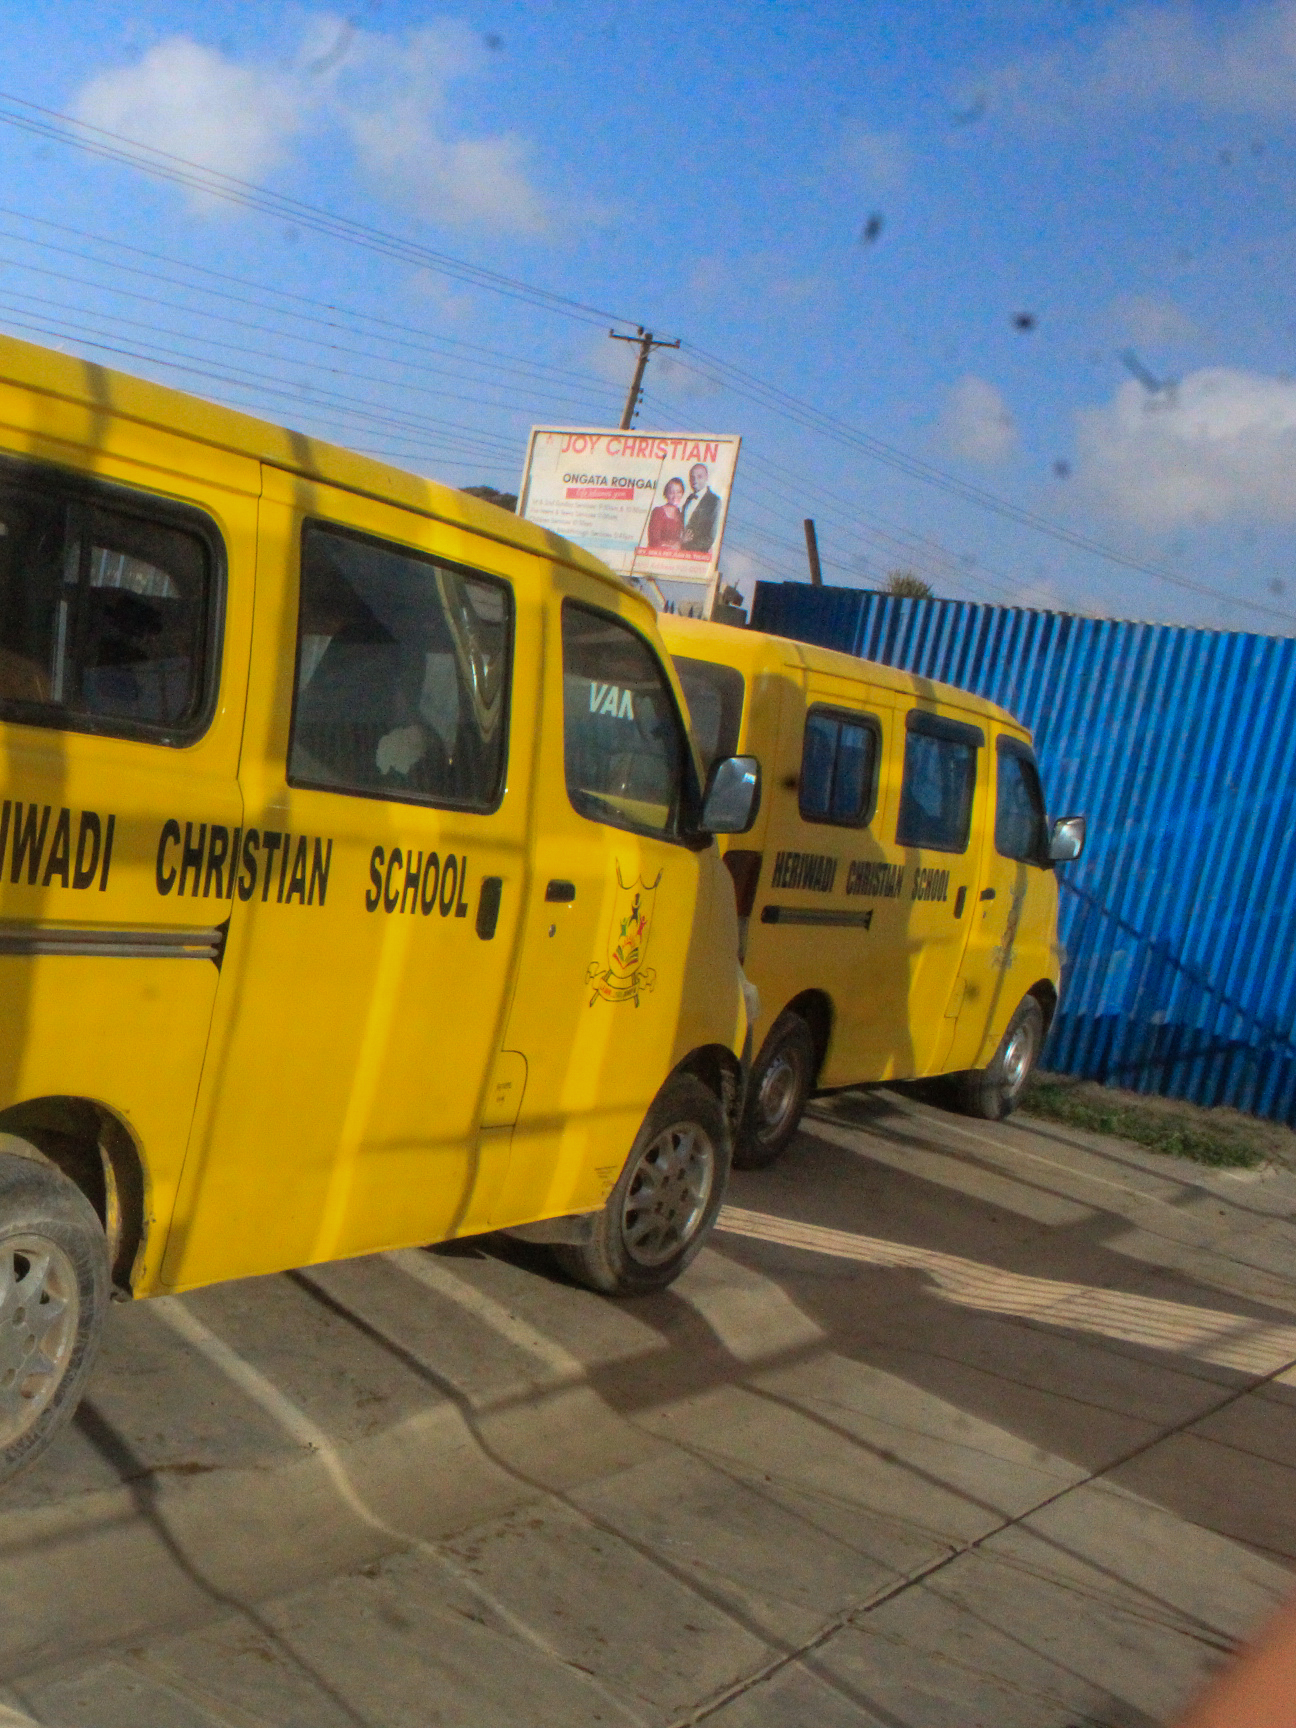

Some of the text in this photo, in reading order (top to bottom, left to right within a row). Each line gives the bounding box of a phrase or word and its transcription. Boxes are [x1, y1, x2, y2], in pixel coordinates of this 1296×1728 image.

[562, 434, 719, 463] JOY CHRISTIAN
[563, 473, 608, 485] ONGATA
[156, 818, 333, 907] CHRISTIAN
[365, 845, 469, 918] SCHOOL
[771, 851, 950, 902] HERIWADI CHRISTIAN SCHOOL
